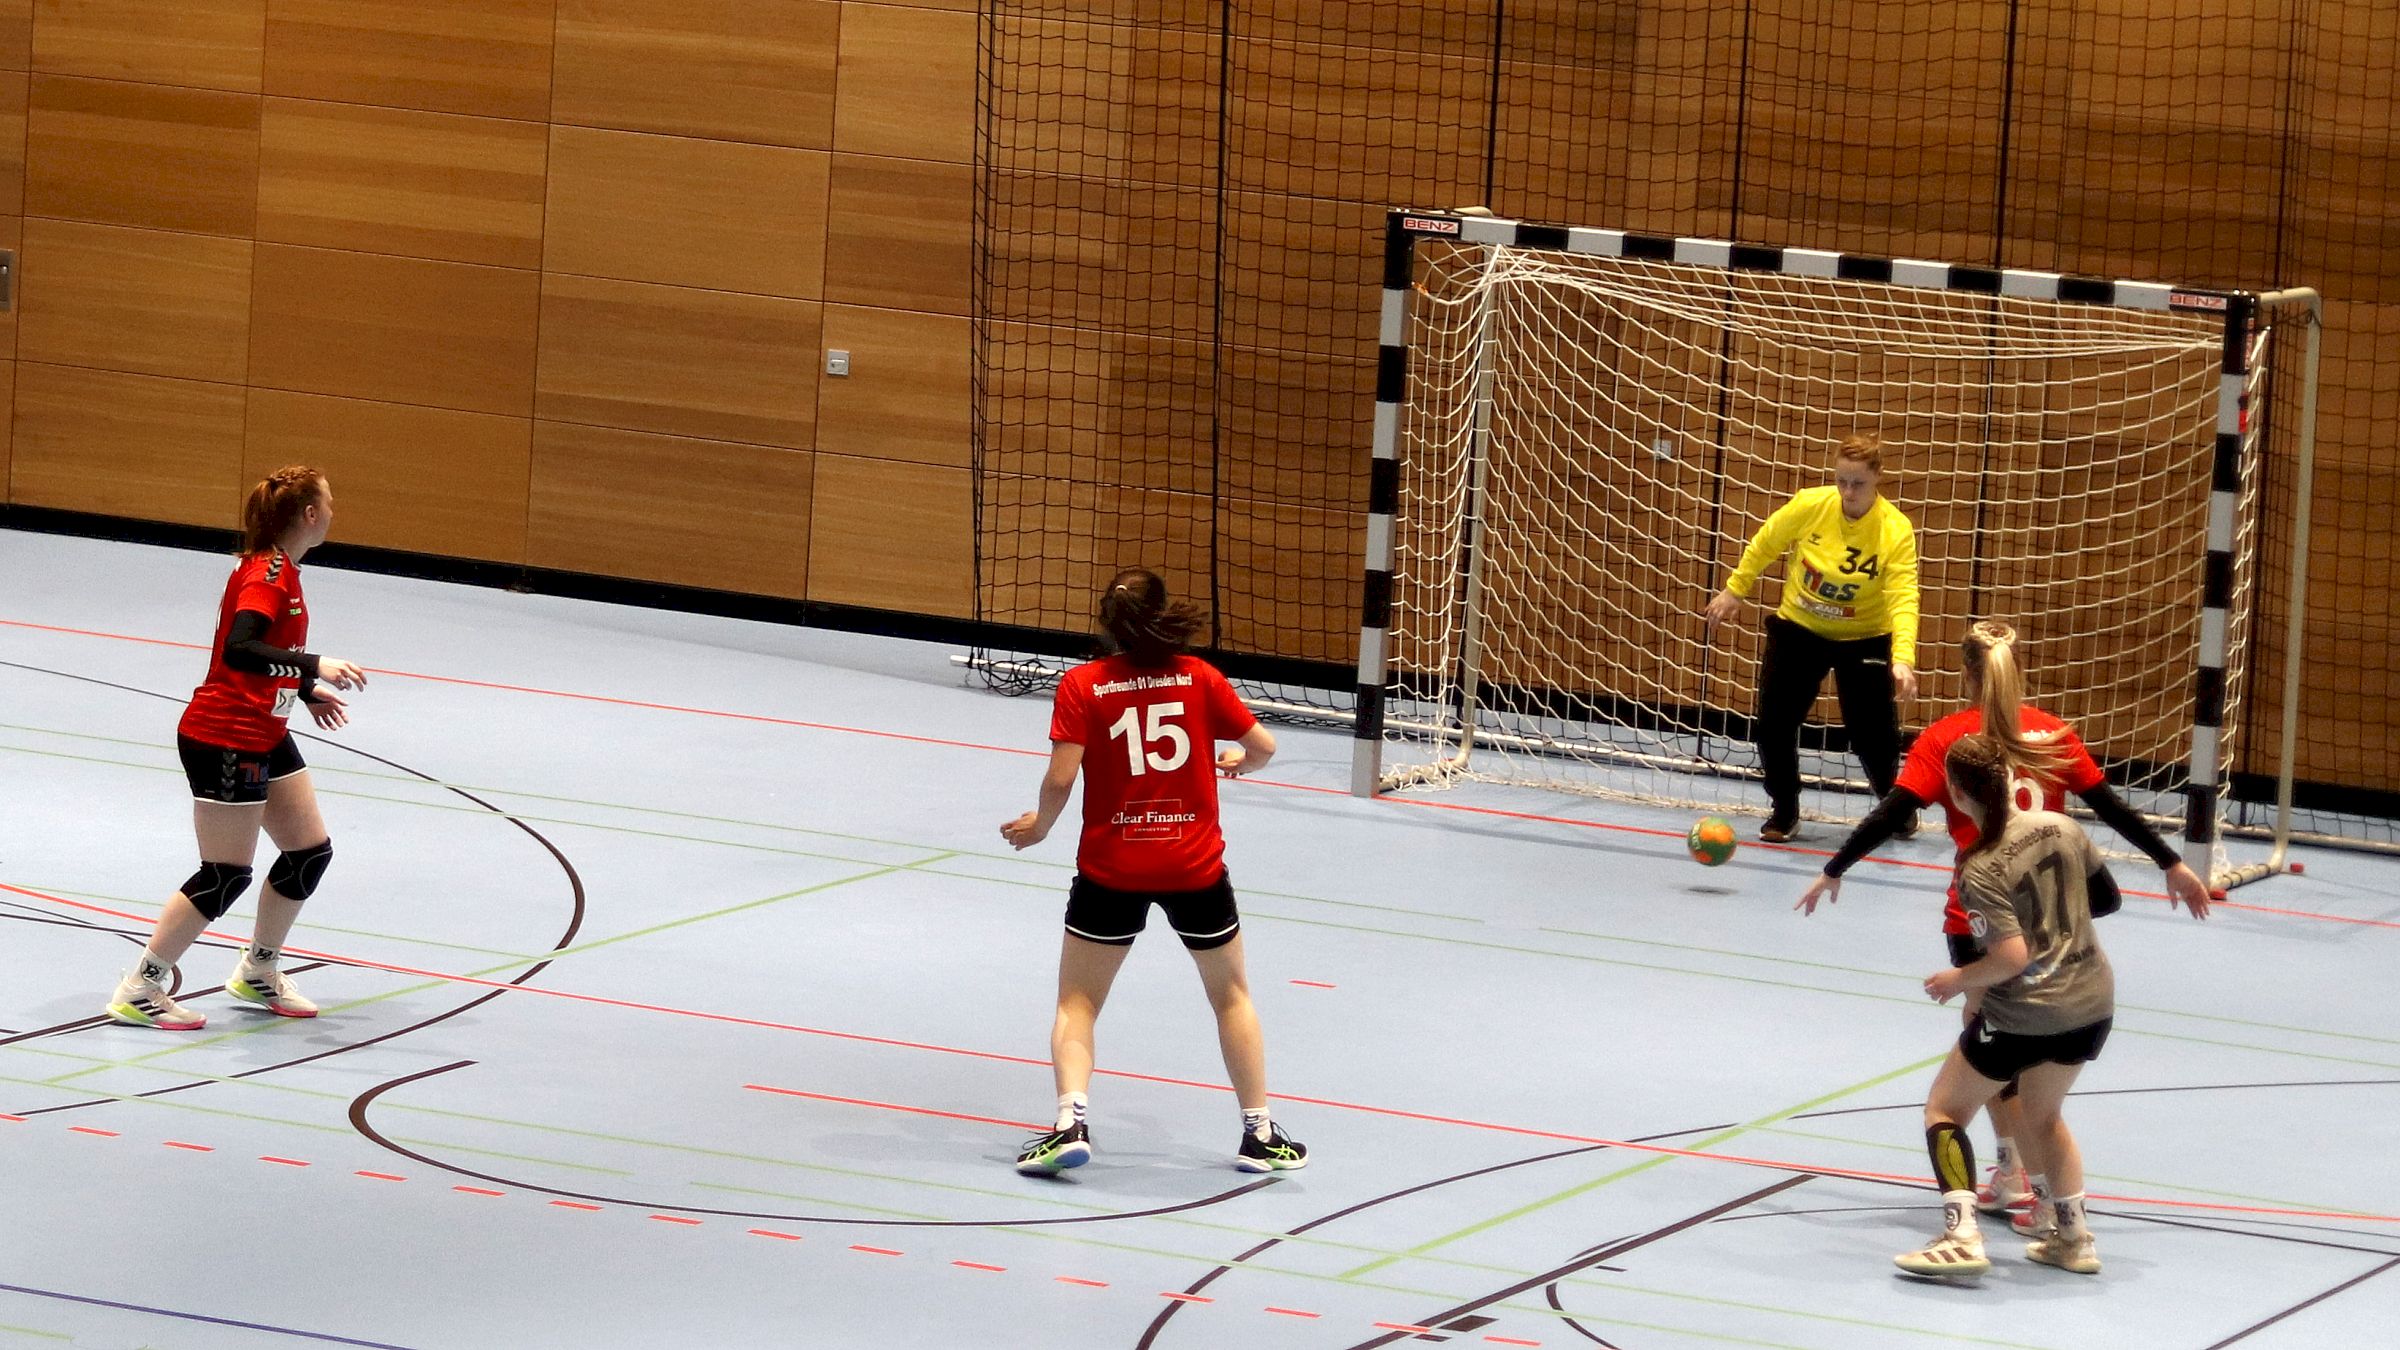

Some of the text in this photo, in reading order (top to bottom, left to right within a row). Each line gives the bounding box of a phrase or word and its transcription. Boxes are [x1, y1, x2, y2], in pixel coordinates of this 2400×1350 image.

[1405, 219, 1455, 231] BENZ
[1839, 546, 1879, 580] 34
[1092, 672, 1193, 698] Sportfreunde 01 Dresden Nord
[1109, 701, 1191, 776] 15
[1111, 810, 1196, 824] Clear Finance
